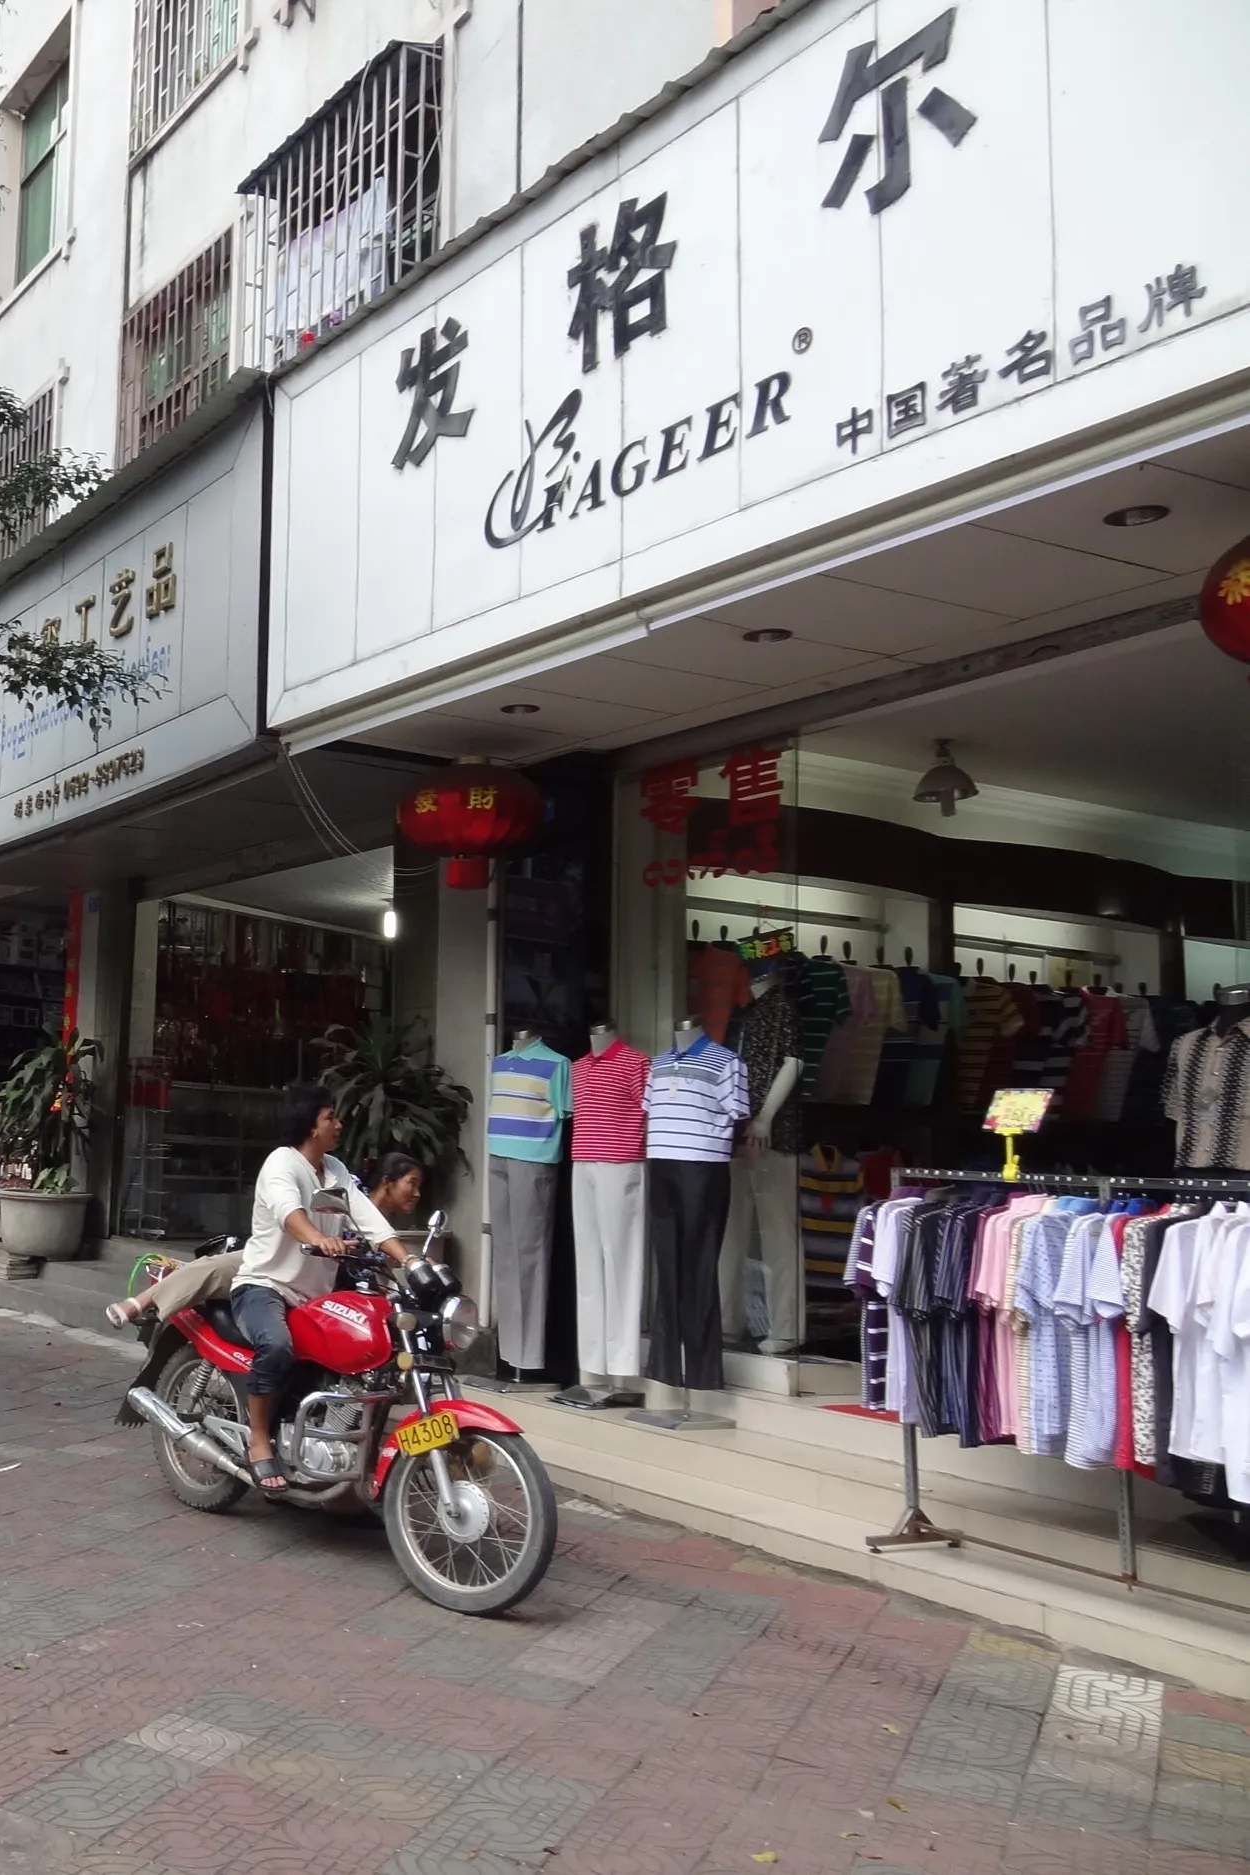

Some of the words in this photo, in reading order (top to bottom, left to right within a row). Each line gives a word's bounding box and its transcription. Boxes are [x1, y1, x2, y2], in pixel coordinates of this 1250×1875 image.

[391, 10, 978, 469] 发格尔
[836, 263, 1207, 455] 中国著名品牌
[536, 369, 792, 534] FAGEER
[413, 786, 498, 814] 發財
[639, 745, 785, 836] 零售
[321, 1299, 369, 1326] SUZUKI
[399, 1415, 455, 1452] H4308
